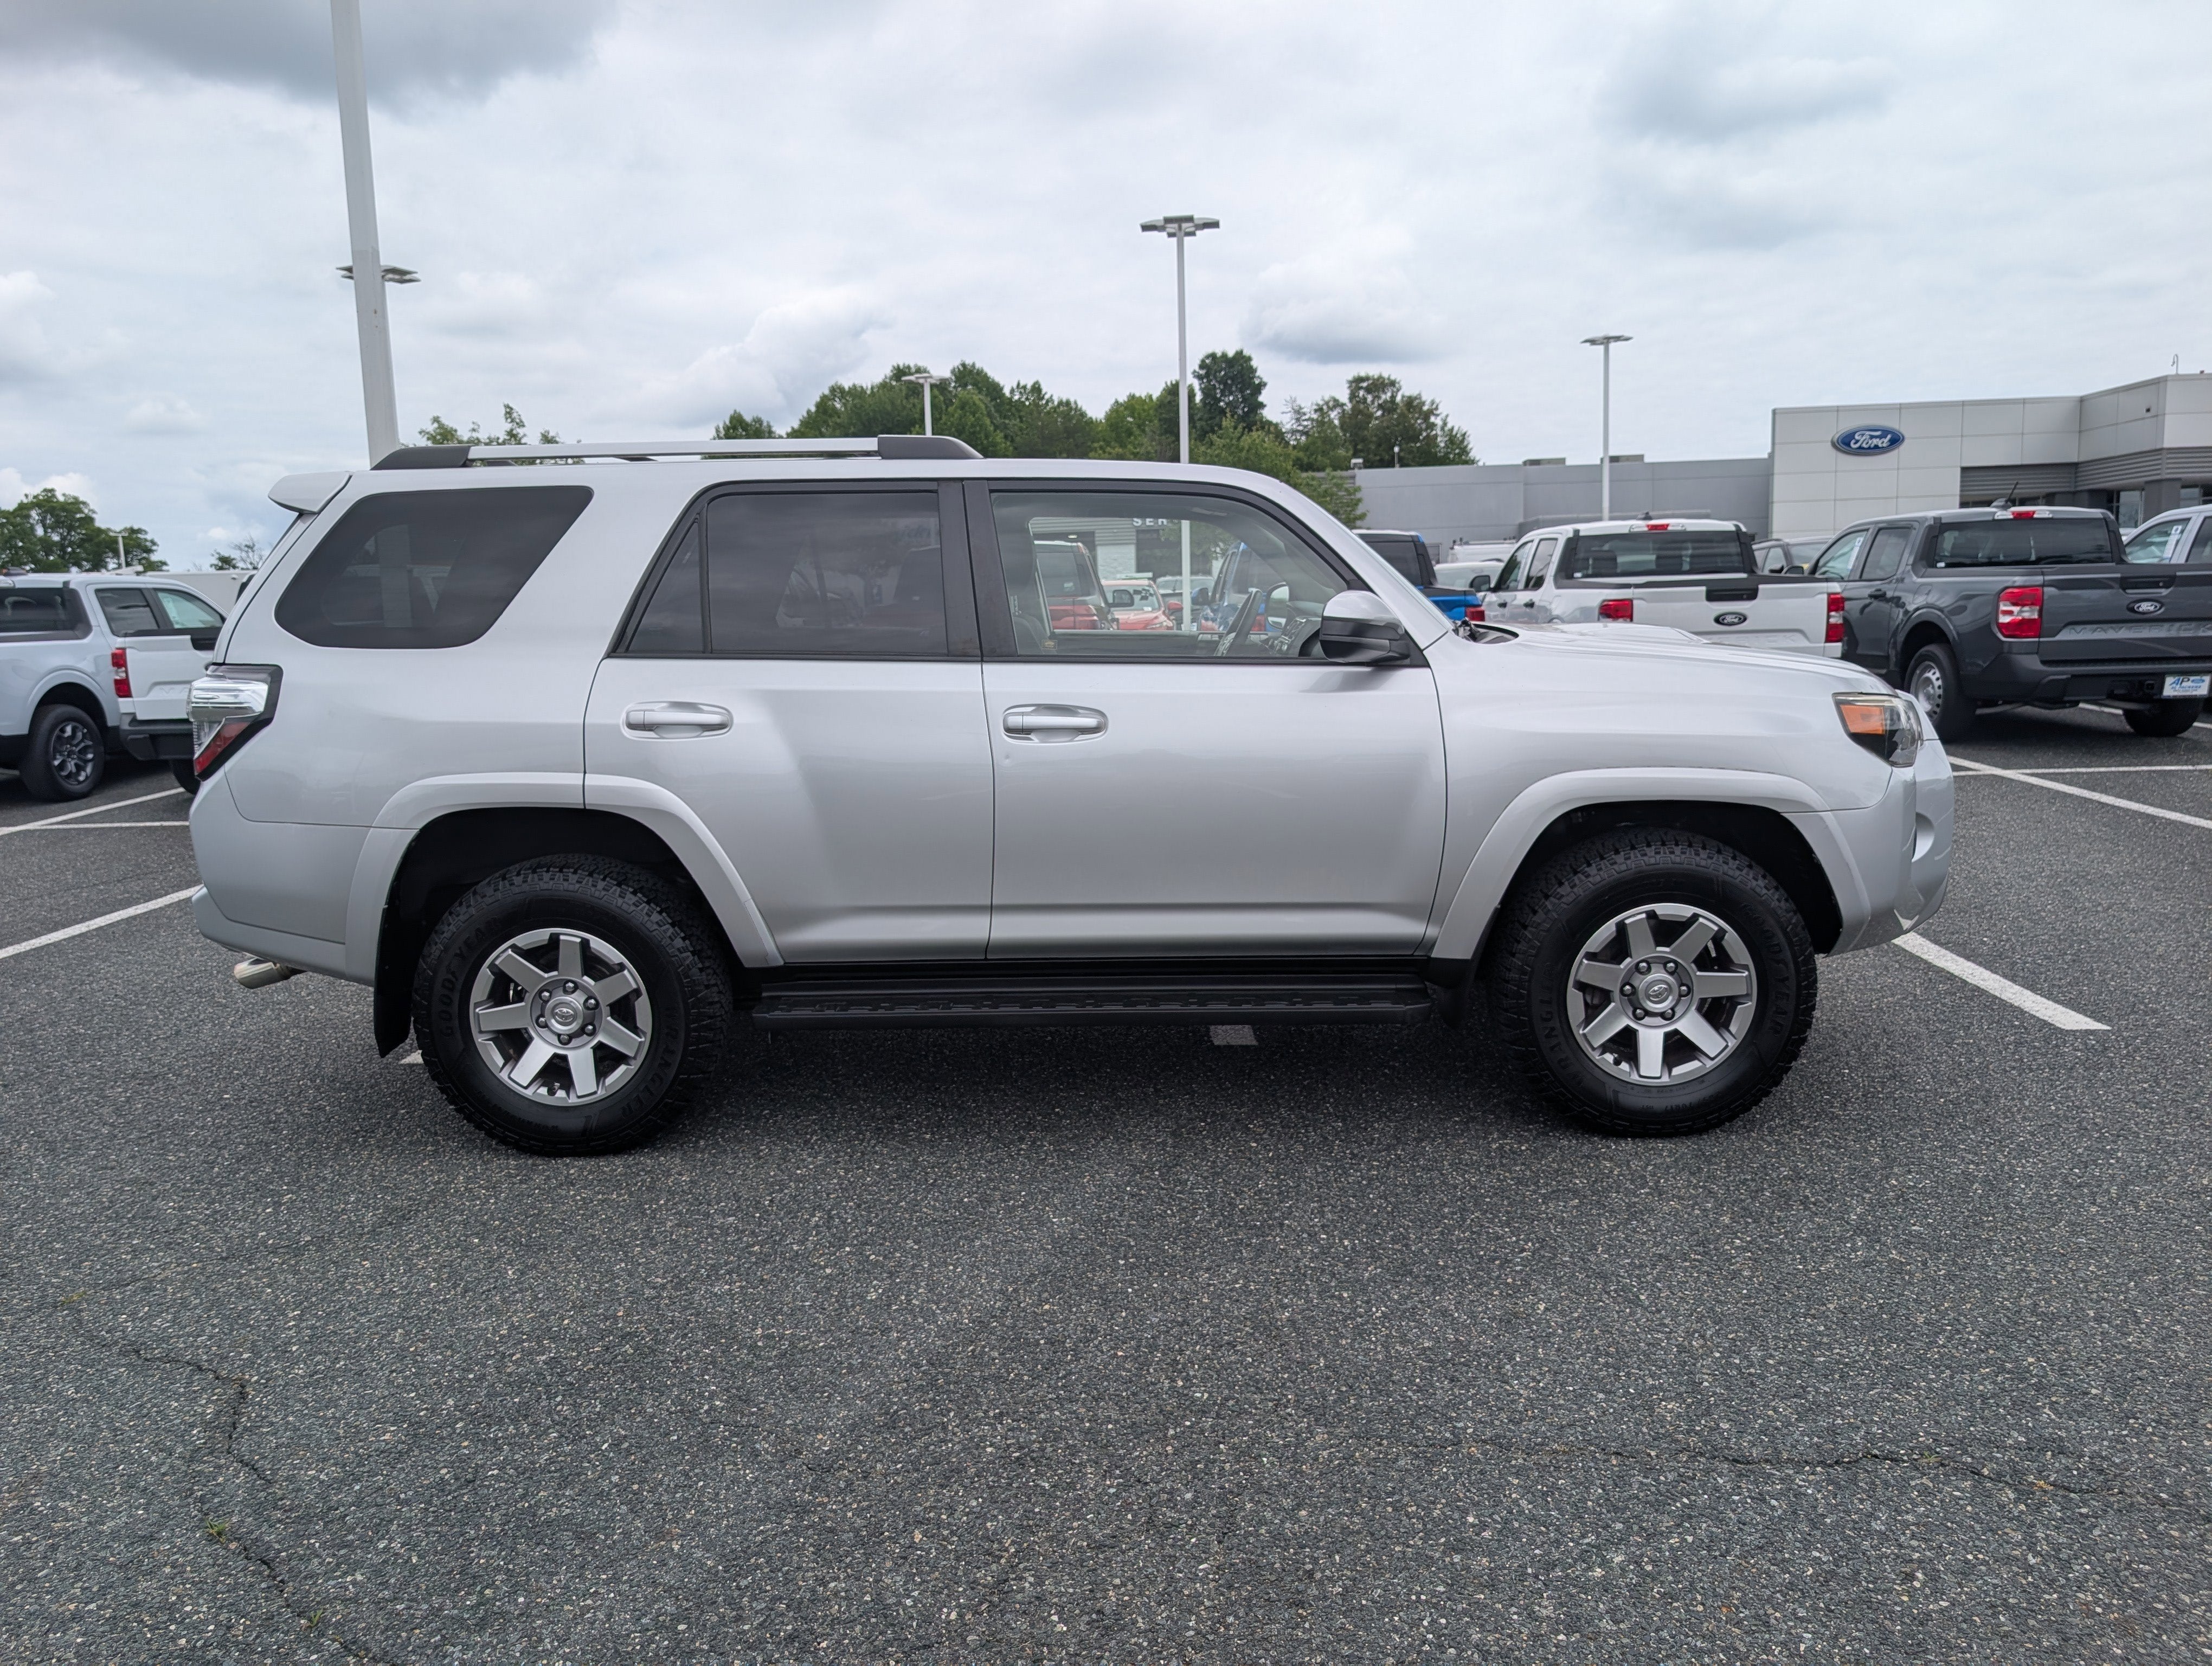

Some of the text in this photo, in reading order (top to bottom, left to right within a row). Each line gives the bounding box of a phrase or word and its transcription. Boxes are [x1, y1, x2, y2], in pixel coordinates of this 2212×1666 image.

[1850, 431, 1892, 448] Ford
[1133, 518, 1179, 527] SER
[2139, 603, 2155, 611] Ford
[438, 915, 500, 1037] GOODYEAR
[1741, 904, 1789, 1036] GOODYEAR
[1539, 962, 1584, 1087] WRANGLER
